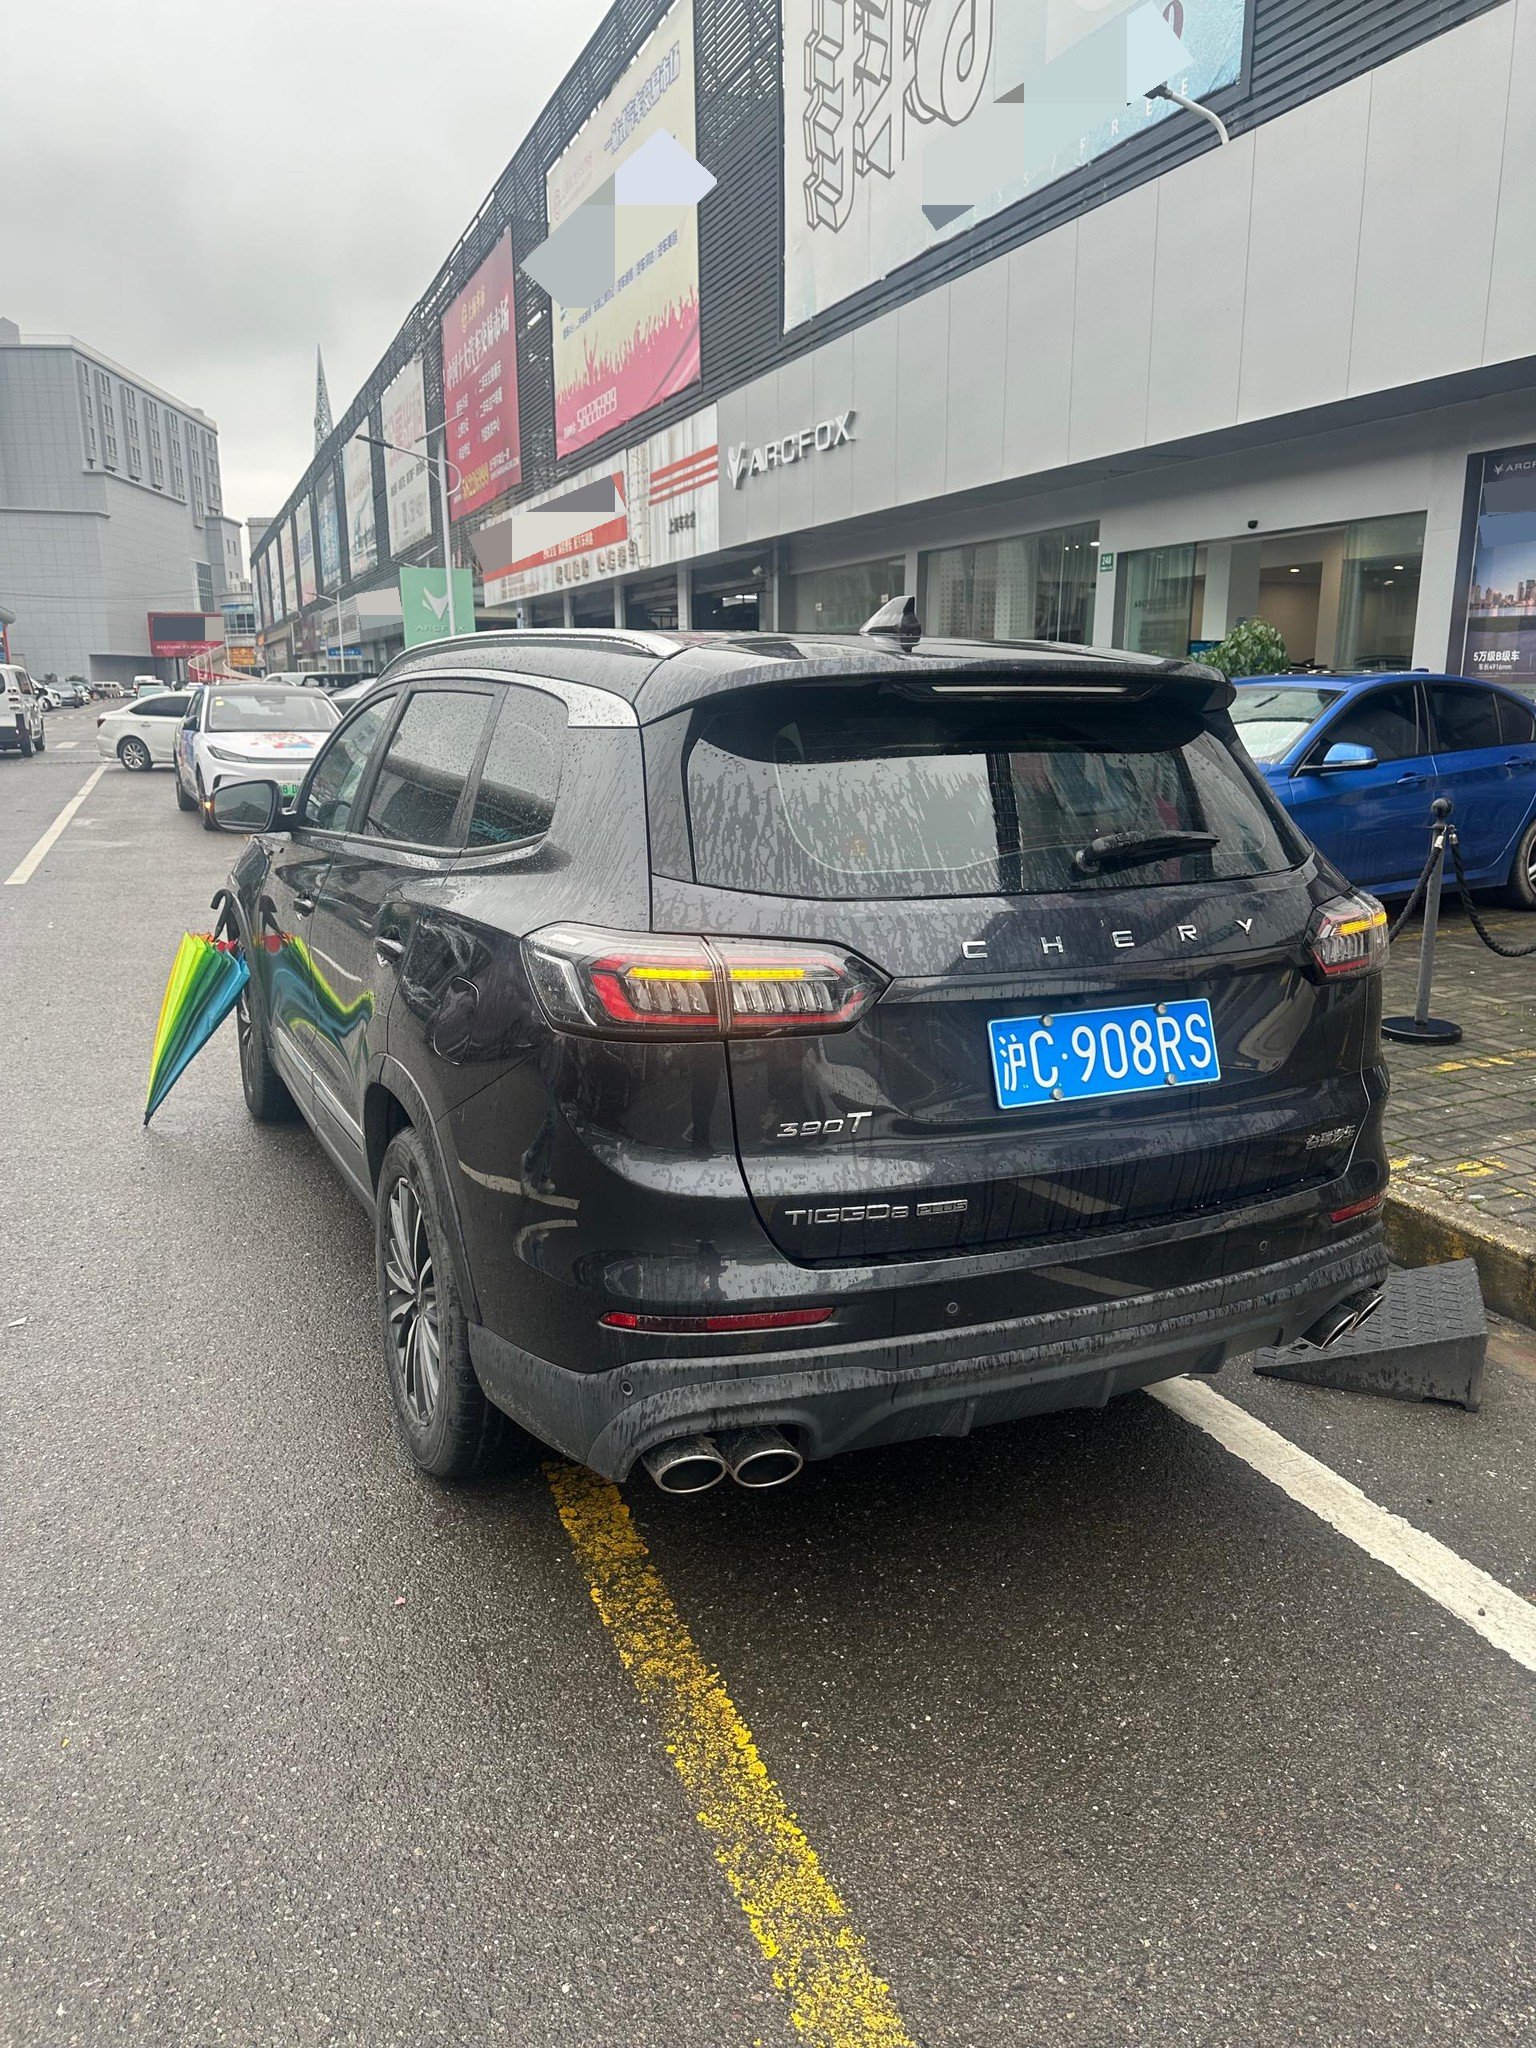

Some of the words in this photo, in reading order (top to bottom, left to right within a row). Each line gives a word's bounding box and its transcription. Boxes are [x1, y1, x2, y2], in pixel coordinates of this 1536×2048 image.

[749, 410, 856, 476] ARCFOX
[415, 624, 465, 634] ARCFX
[1473, 649, 1520, 662] 5万级B级车
[961, 918, 1253, 960] CHERY
[776, 1111, 873, 1138] 390T
[918, 1200, 967, 1216] PLUS
